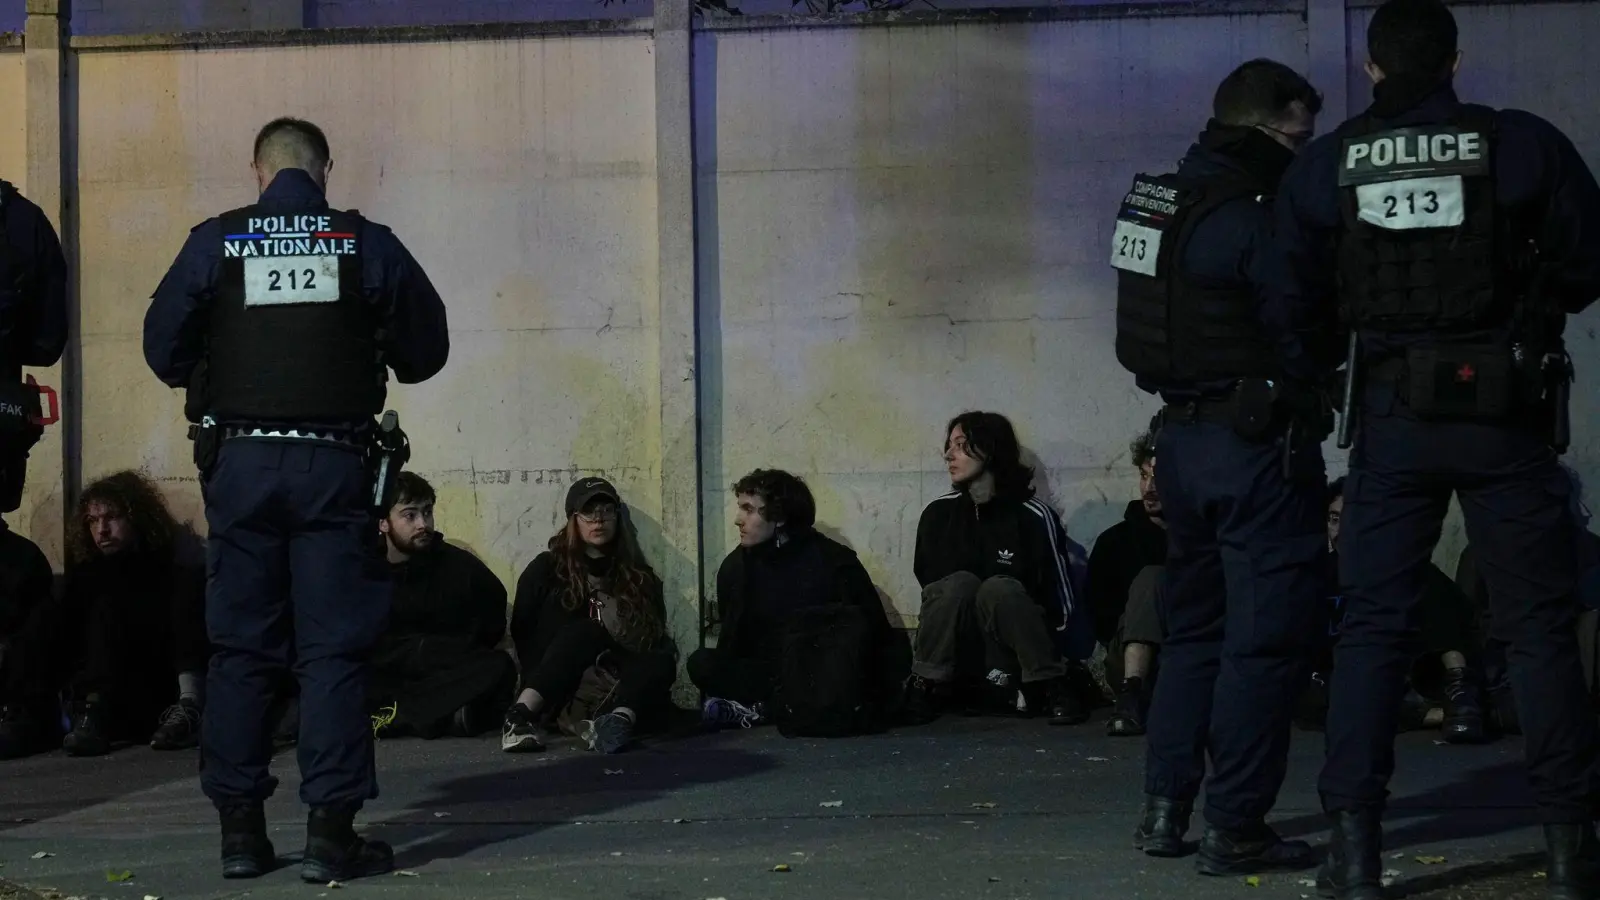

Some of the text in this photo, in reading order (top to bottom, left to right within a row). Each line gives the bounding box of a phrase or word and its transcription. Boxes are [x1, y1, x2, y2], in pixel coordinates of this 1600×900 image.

[1346, 132, 1481, 169] POLICE
[1135, 181, 1178, 201] COMPAGNIE
[1383, 191, 1439, 219] 213
[248, 215, 331, 233] POLICE
[224, 238, 356, 257] NATIONALE
[1119, 235, 1146, 260] 213
[268, 269, 316, 291] 212
